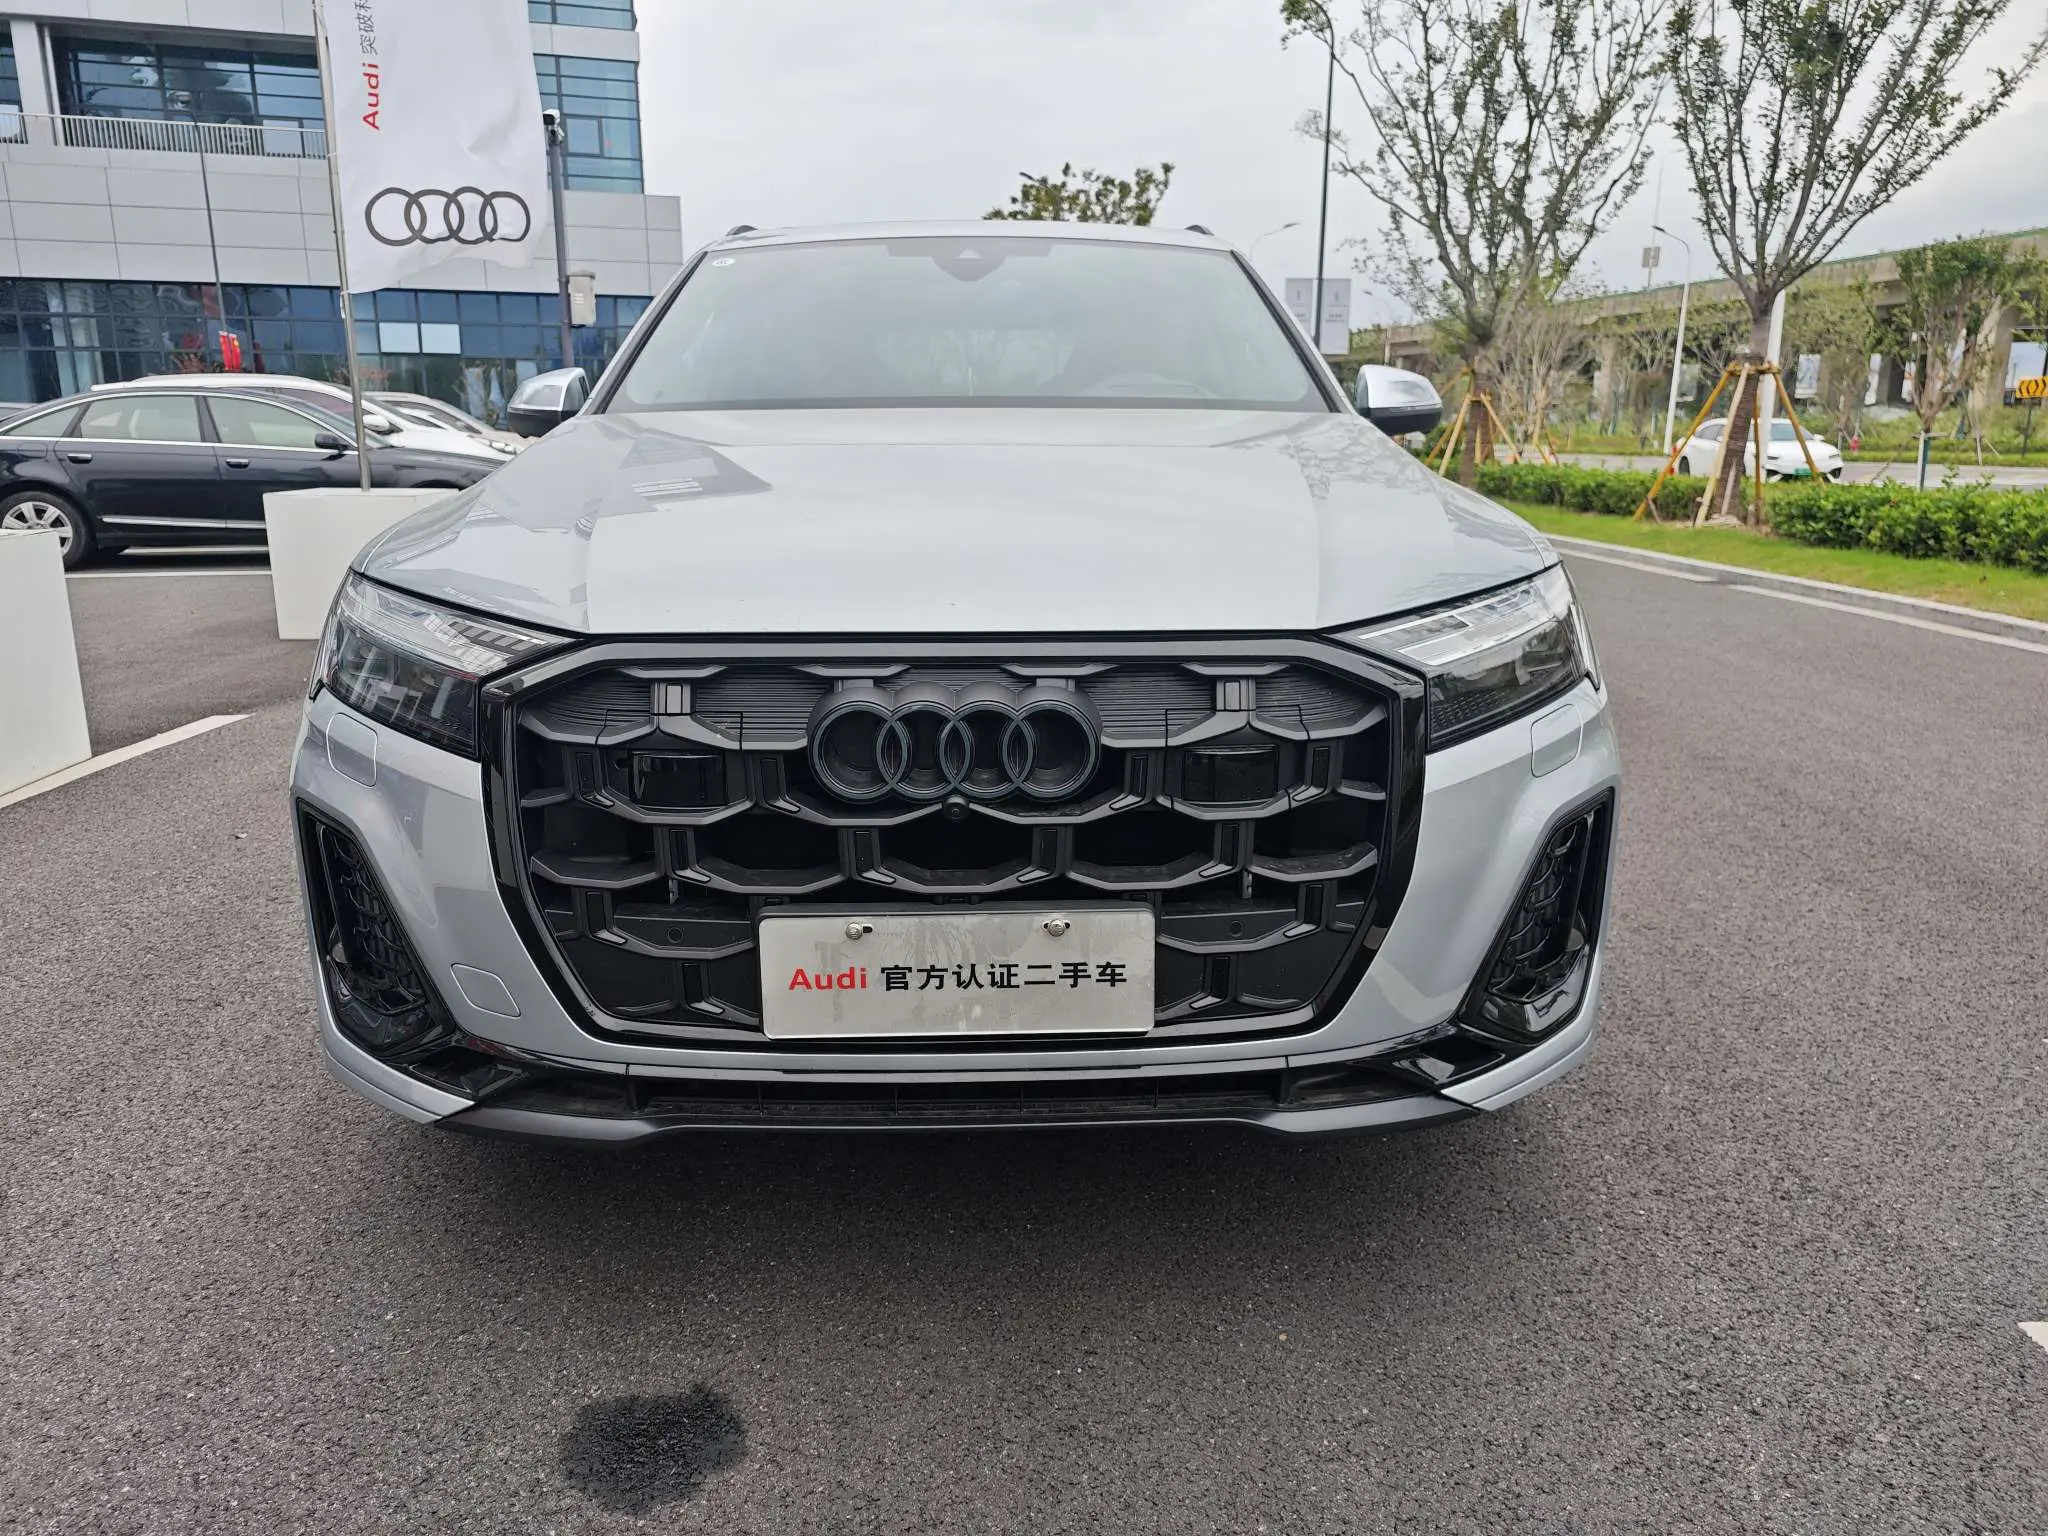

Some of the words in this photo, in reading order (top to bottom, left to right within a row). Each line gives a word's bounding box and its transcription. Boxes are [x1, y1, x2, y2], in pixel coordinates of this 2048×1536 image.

[362, 62, 380, 130] Audi
[788, 966, 867, 991] Audi
[880, 961, 1128, 991] 官方认证二手车
